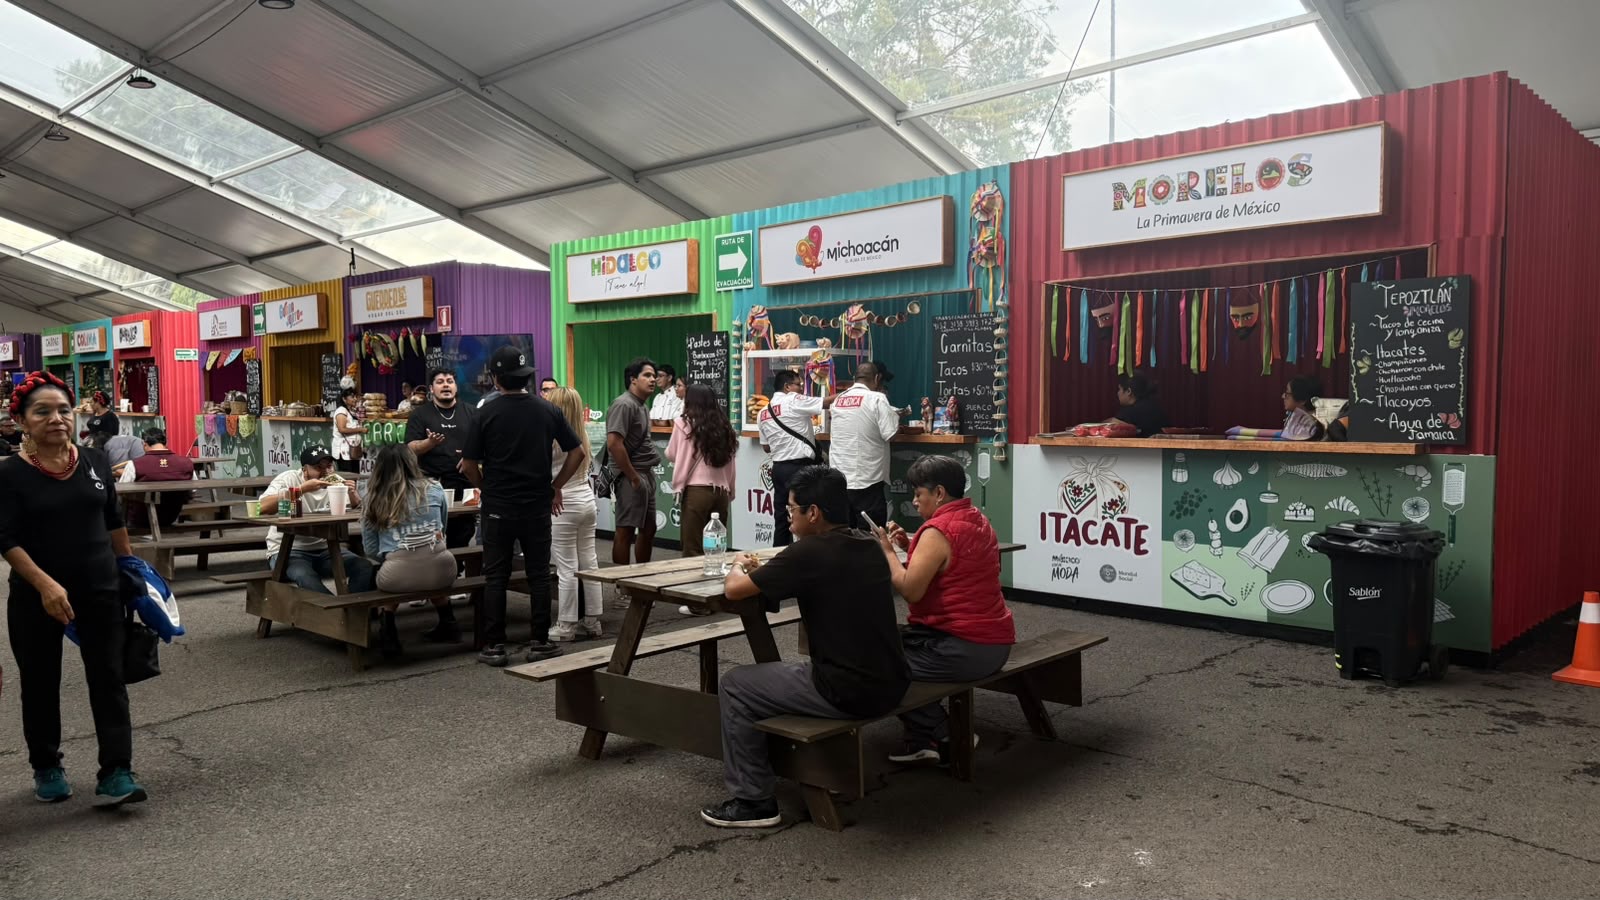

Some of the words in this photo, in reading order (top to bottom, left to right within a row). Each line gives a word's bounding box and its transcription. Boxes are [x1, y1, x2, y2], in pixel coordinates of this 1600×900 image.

[1112, 153, 1313, 211] MORELOS
[1136, 217, 1150, 229] La
[1153, 210, 1212, 226] Primavera
[1215, 205, 1230, 219] de
[1232, 200, 1281, 218] México
[721, 238, 736, 246] RUTA
[736, 236, 745, 244] DE
[827, 235, 899, 262] Michoacán
[716, 276, 751, 288] EVACUACIÓN
[1374, 314, 1402, 329] Tacos
[1404, 317, 1414, 328] de
[940, 332, 993, 354] Carnitas
[937, 361, 968, 377] Tacos
[1427, 363, 1446, 371] chile
[935, 380, 970, 397] Tortas
[1389, 412, 1423, 432] Agua
[1426, 413, 1443, 428] de
[268, 450, 290, 467] ITACATE
[1040, 512, 1149, 556] ITACATE
[1051, 566, 1079, 583] MODA
